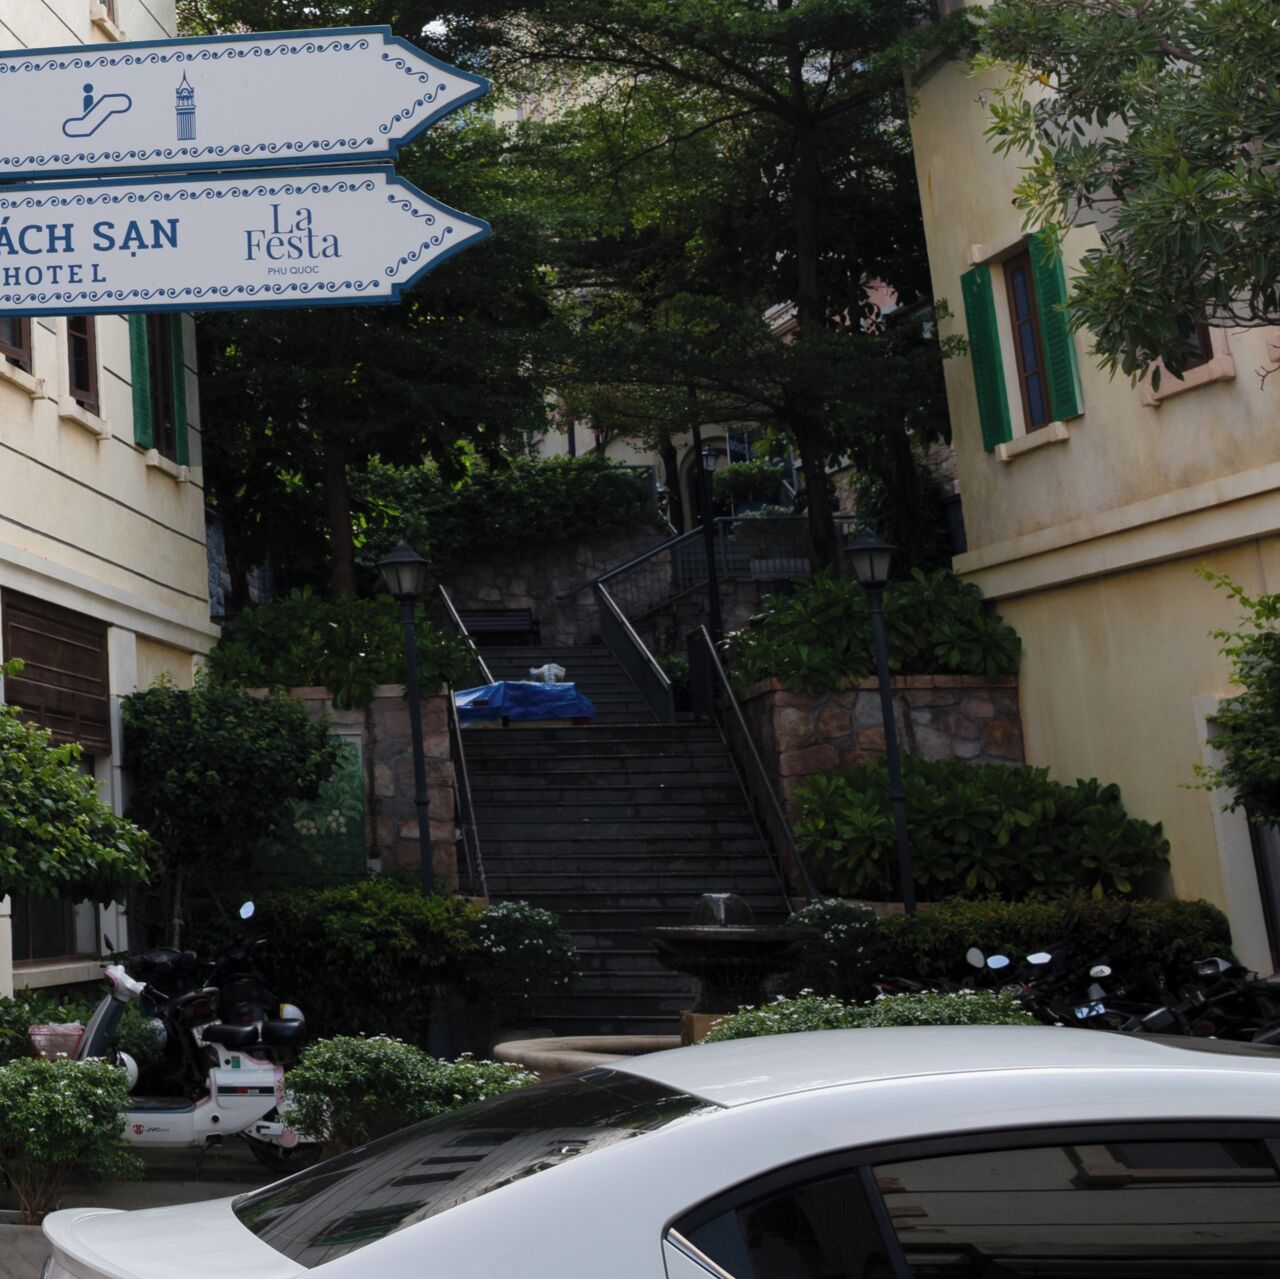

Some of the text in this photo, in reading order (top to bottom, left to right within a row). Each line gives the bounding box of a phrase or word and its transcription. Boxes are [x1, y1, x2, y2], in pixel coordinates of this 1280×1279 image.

[270, 203, 312, 235] La
[93, 218, 180, 258] SẠN
[243, 226, 342, 261] Festa
[3, 264, 106, 287] HOTEL
[267, 265, 320, 276] PHU QUOC
